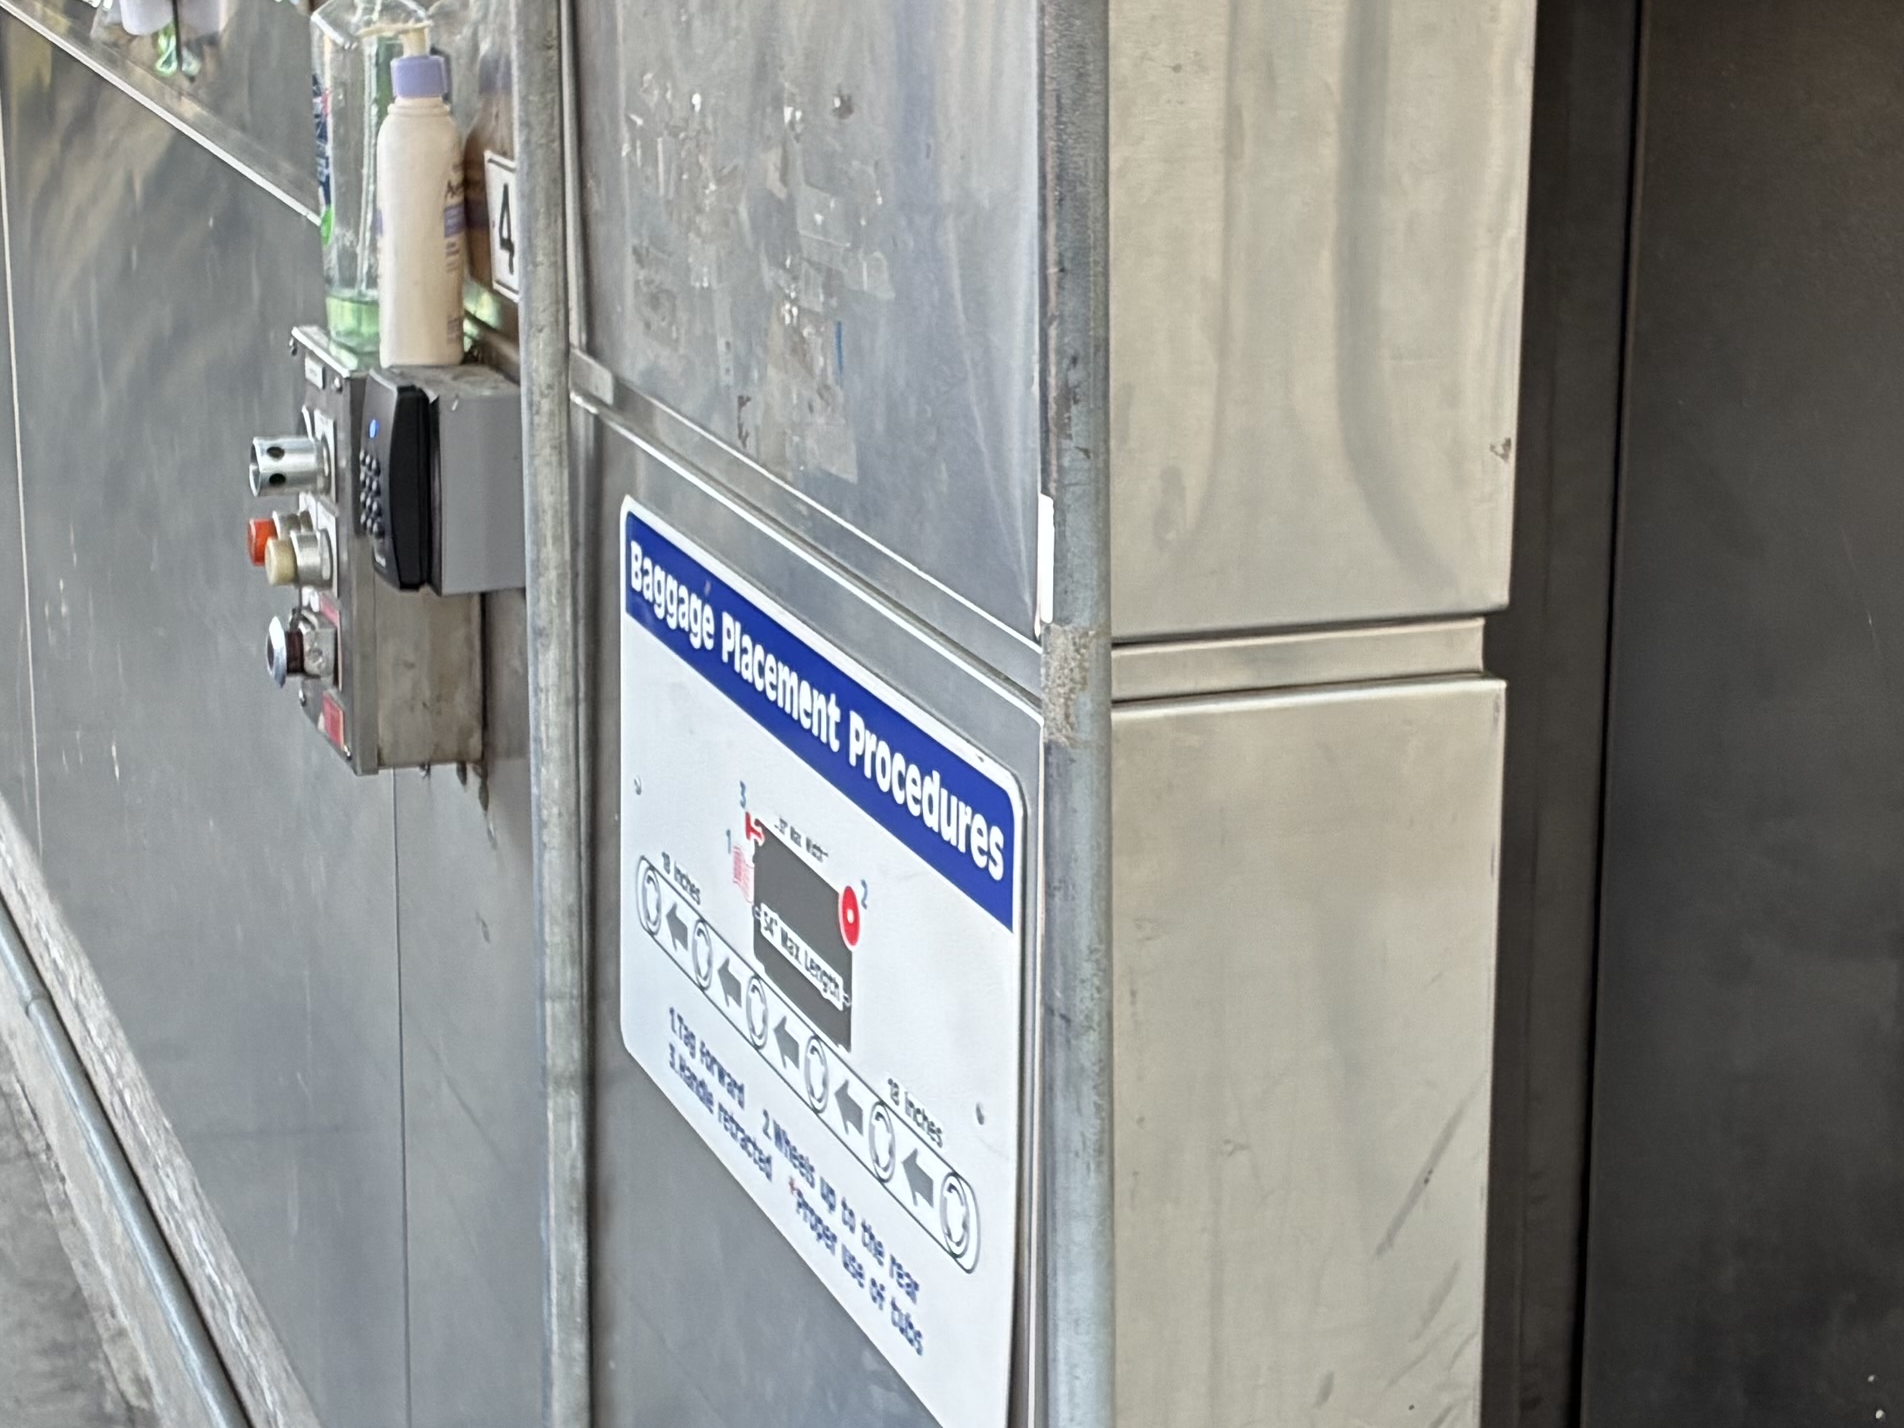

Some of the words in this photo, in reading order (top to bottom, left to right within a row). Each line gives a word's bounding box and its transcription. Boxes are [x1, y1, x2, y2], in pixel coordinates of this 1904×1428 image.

[498, 182, 515, 276] 4
[629, 540, 716, 650] Baggage
[721, 611, 841, 753] Placement
[848, 709, 1006, 882] Procedures
